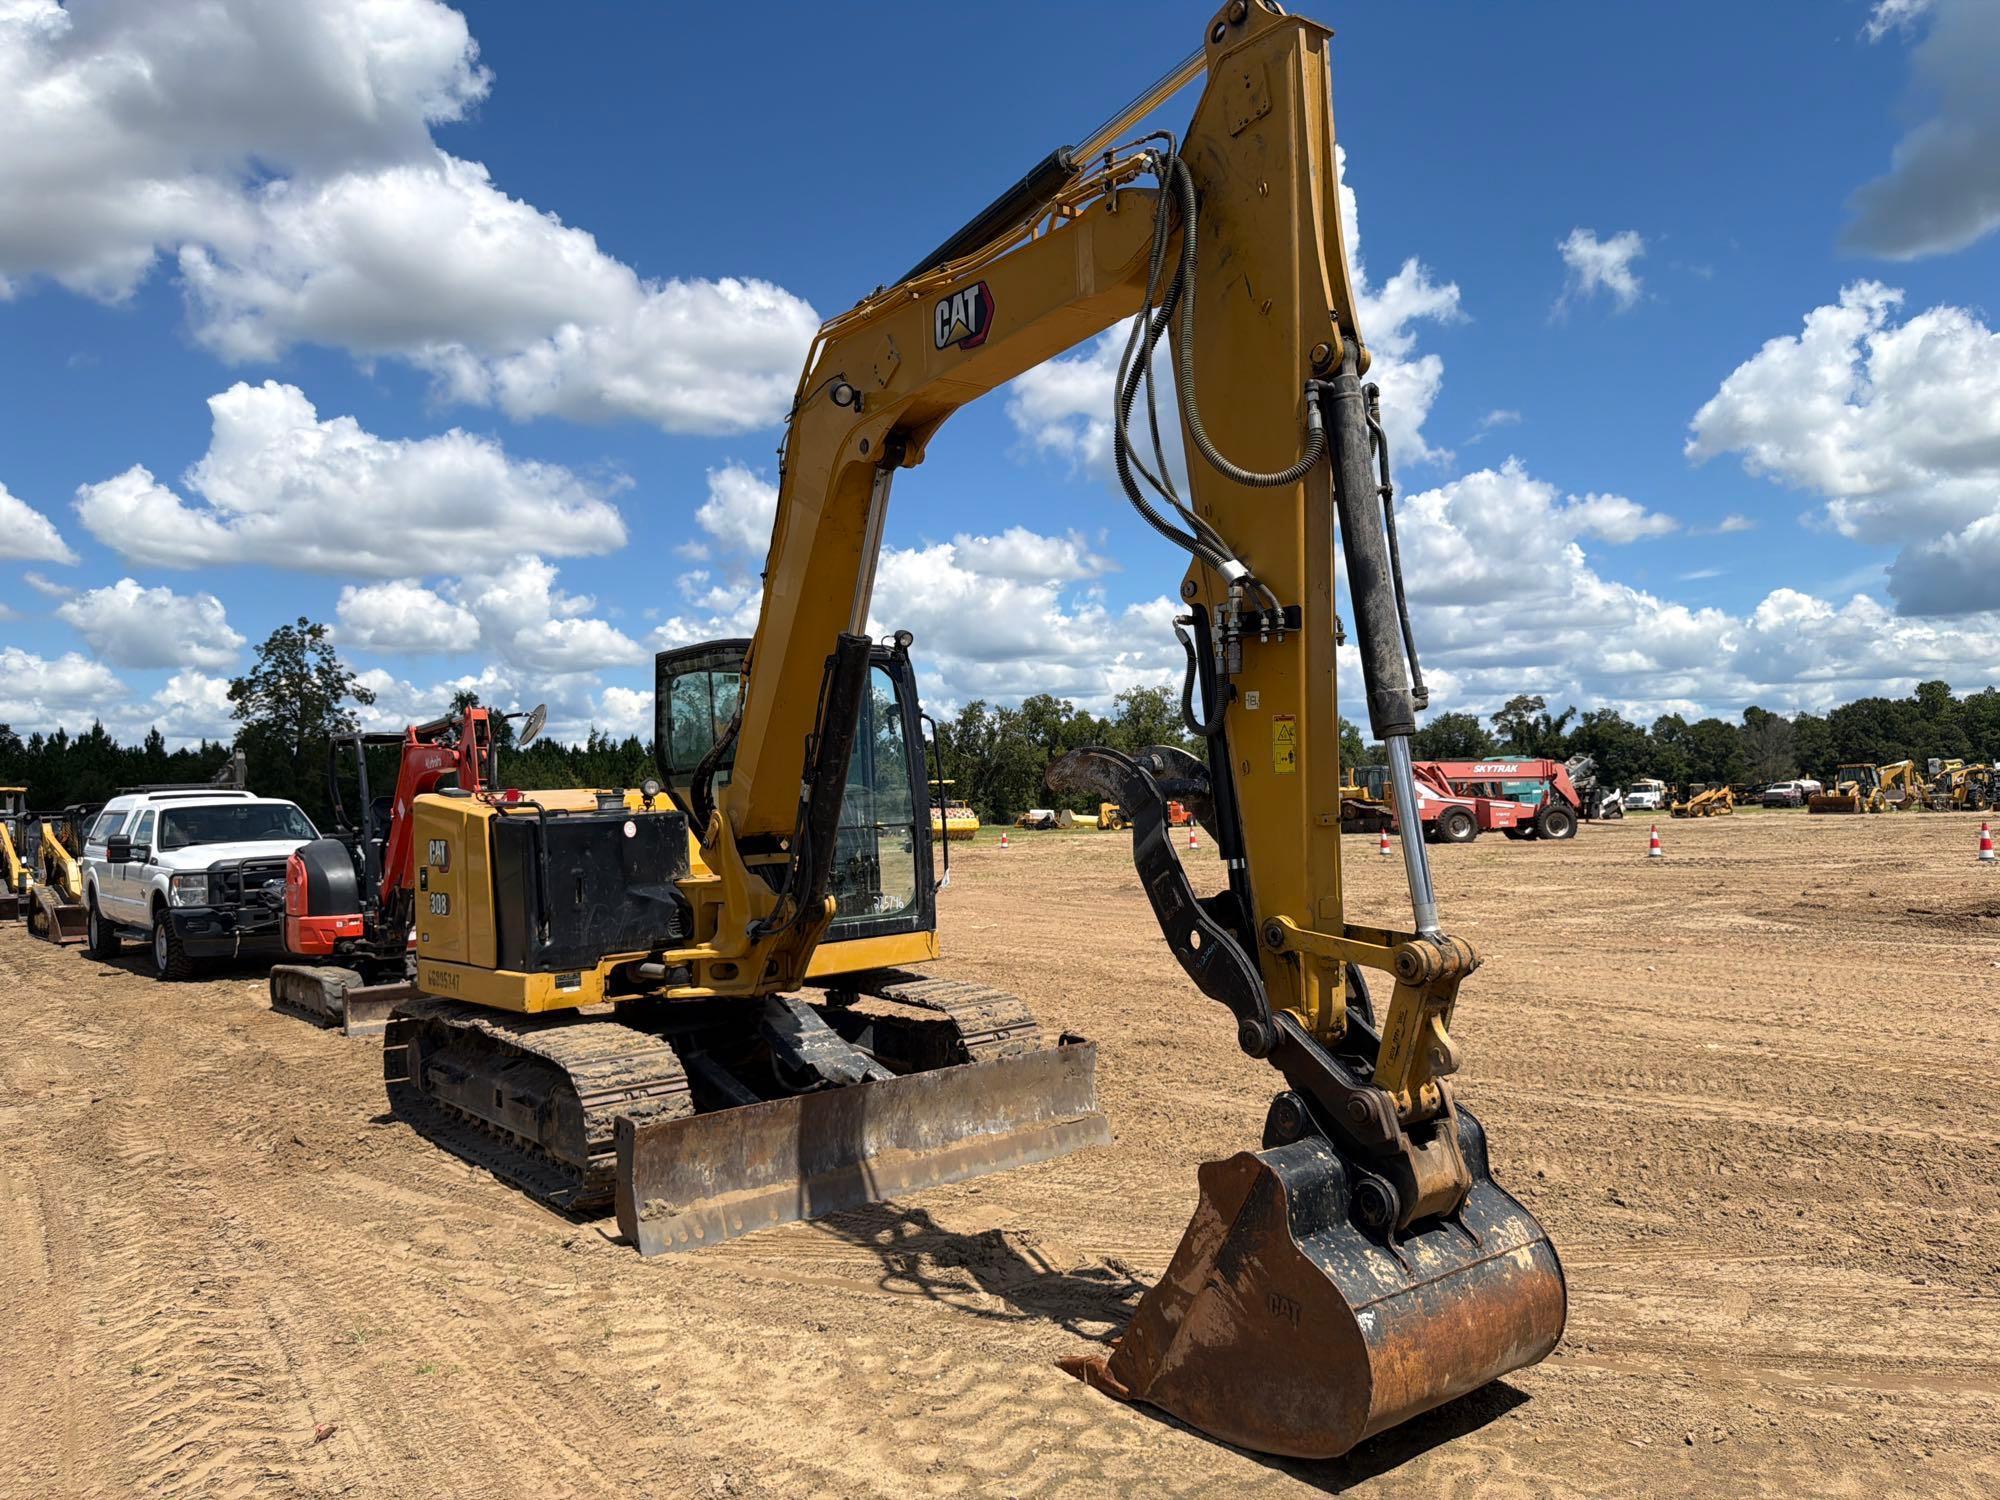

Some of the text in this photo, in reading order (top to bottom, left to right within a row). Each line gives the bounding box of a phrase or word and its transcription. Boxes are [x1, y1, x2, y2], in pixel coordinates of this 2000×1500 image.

[935, 284, 979, 348] CAT
[1473, 764, 1518, 773] SKYTRAK
[429, 840, 446, 866] CAT
[430, 893, 446, 914] 308
